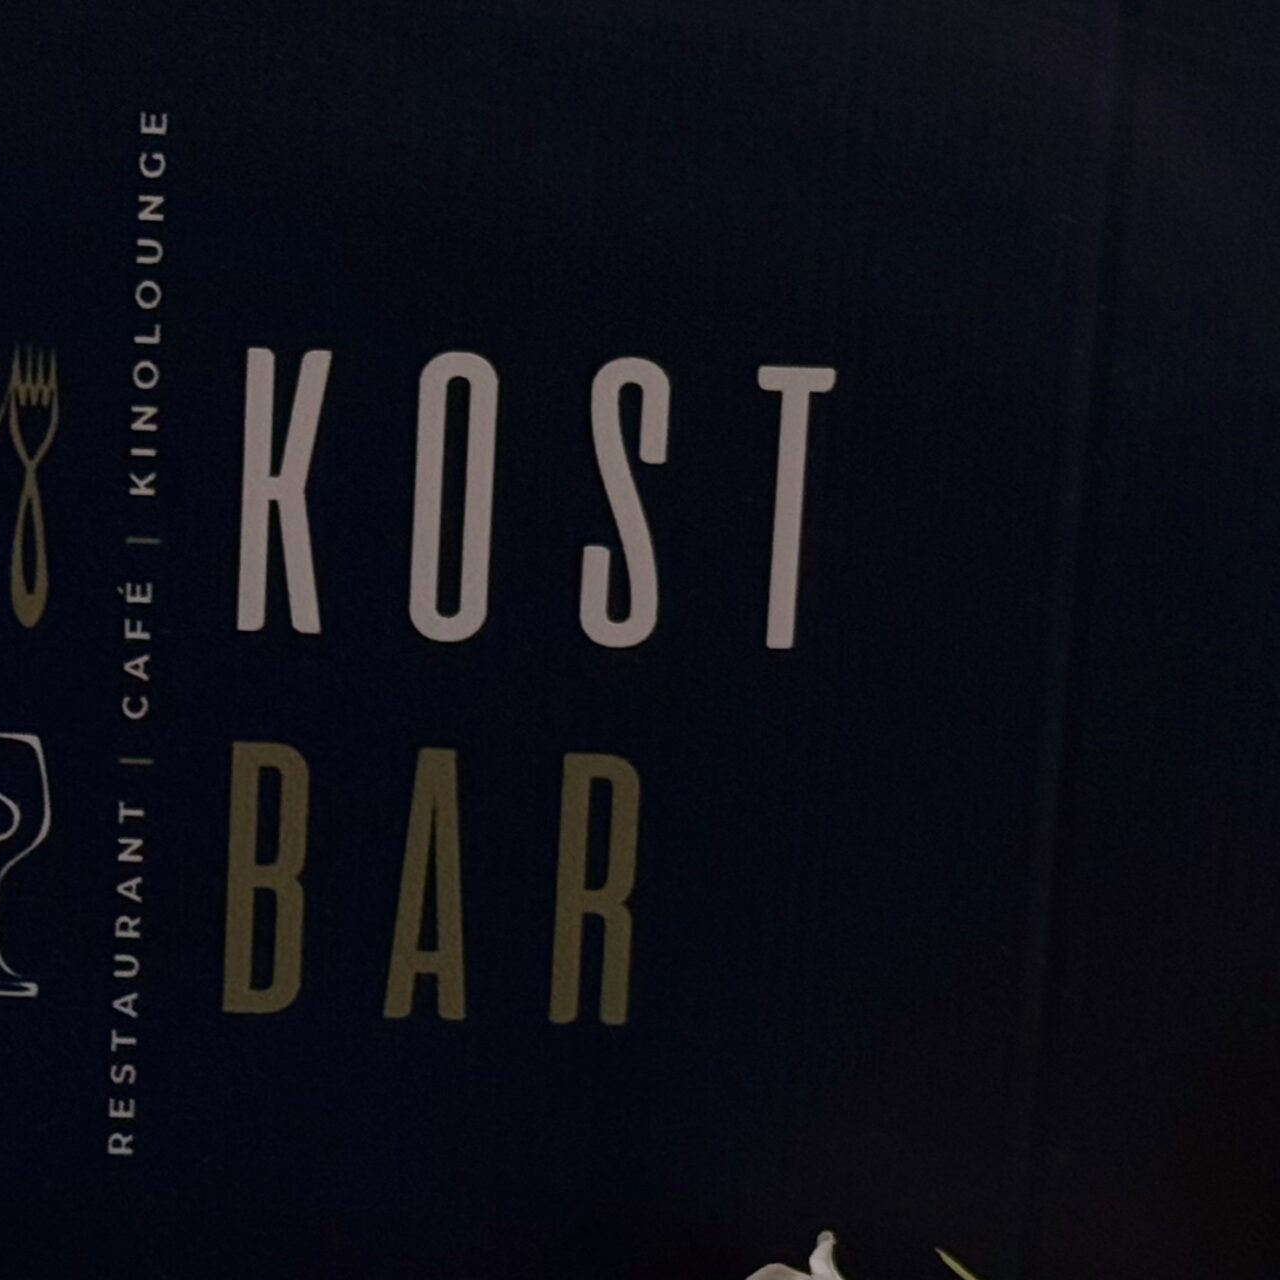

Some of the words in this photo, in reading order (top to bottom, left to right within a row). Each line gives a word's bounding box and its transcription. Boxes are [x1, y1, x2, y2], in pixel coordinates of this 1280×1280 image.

[128, 111, 169, 497] KINOLOUNGE
[236, 346, 837, 650] KOST
[118, 582, 154, 721] CAFÉ
[107, 800, 146, 1156] RESTAURANT
[222, 741, 640, 1025] BAR
